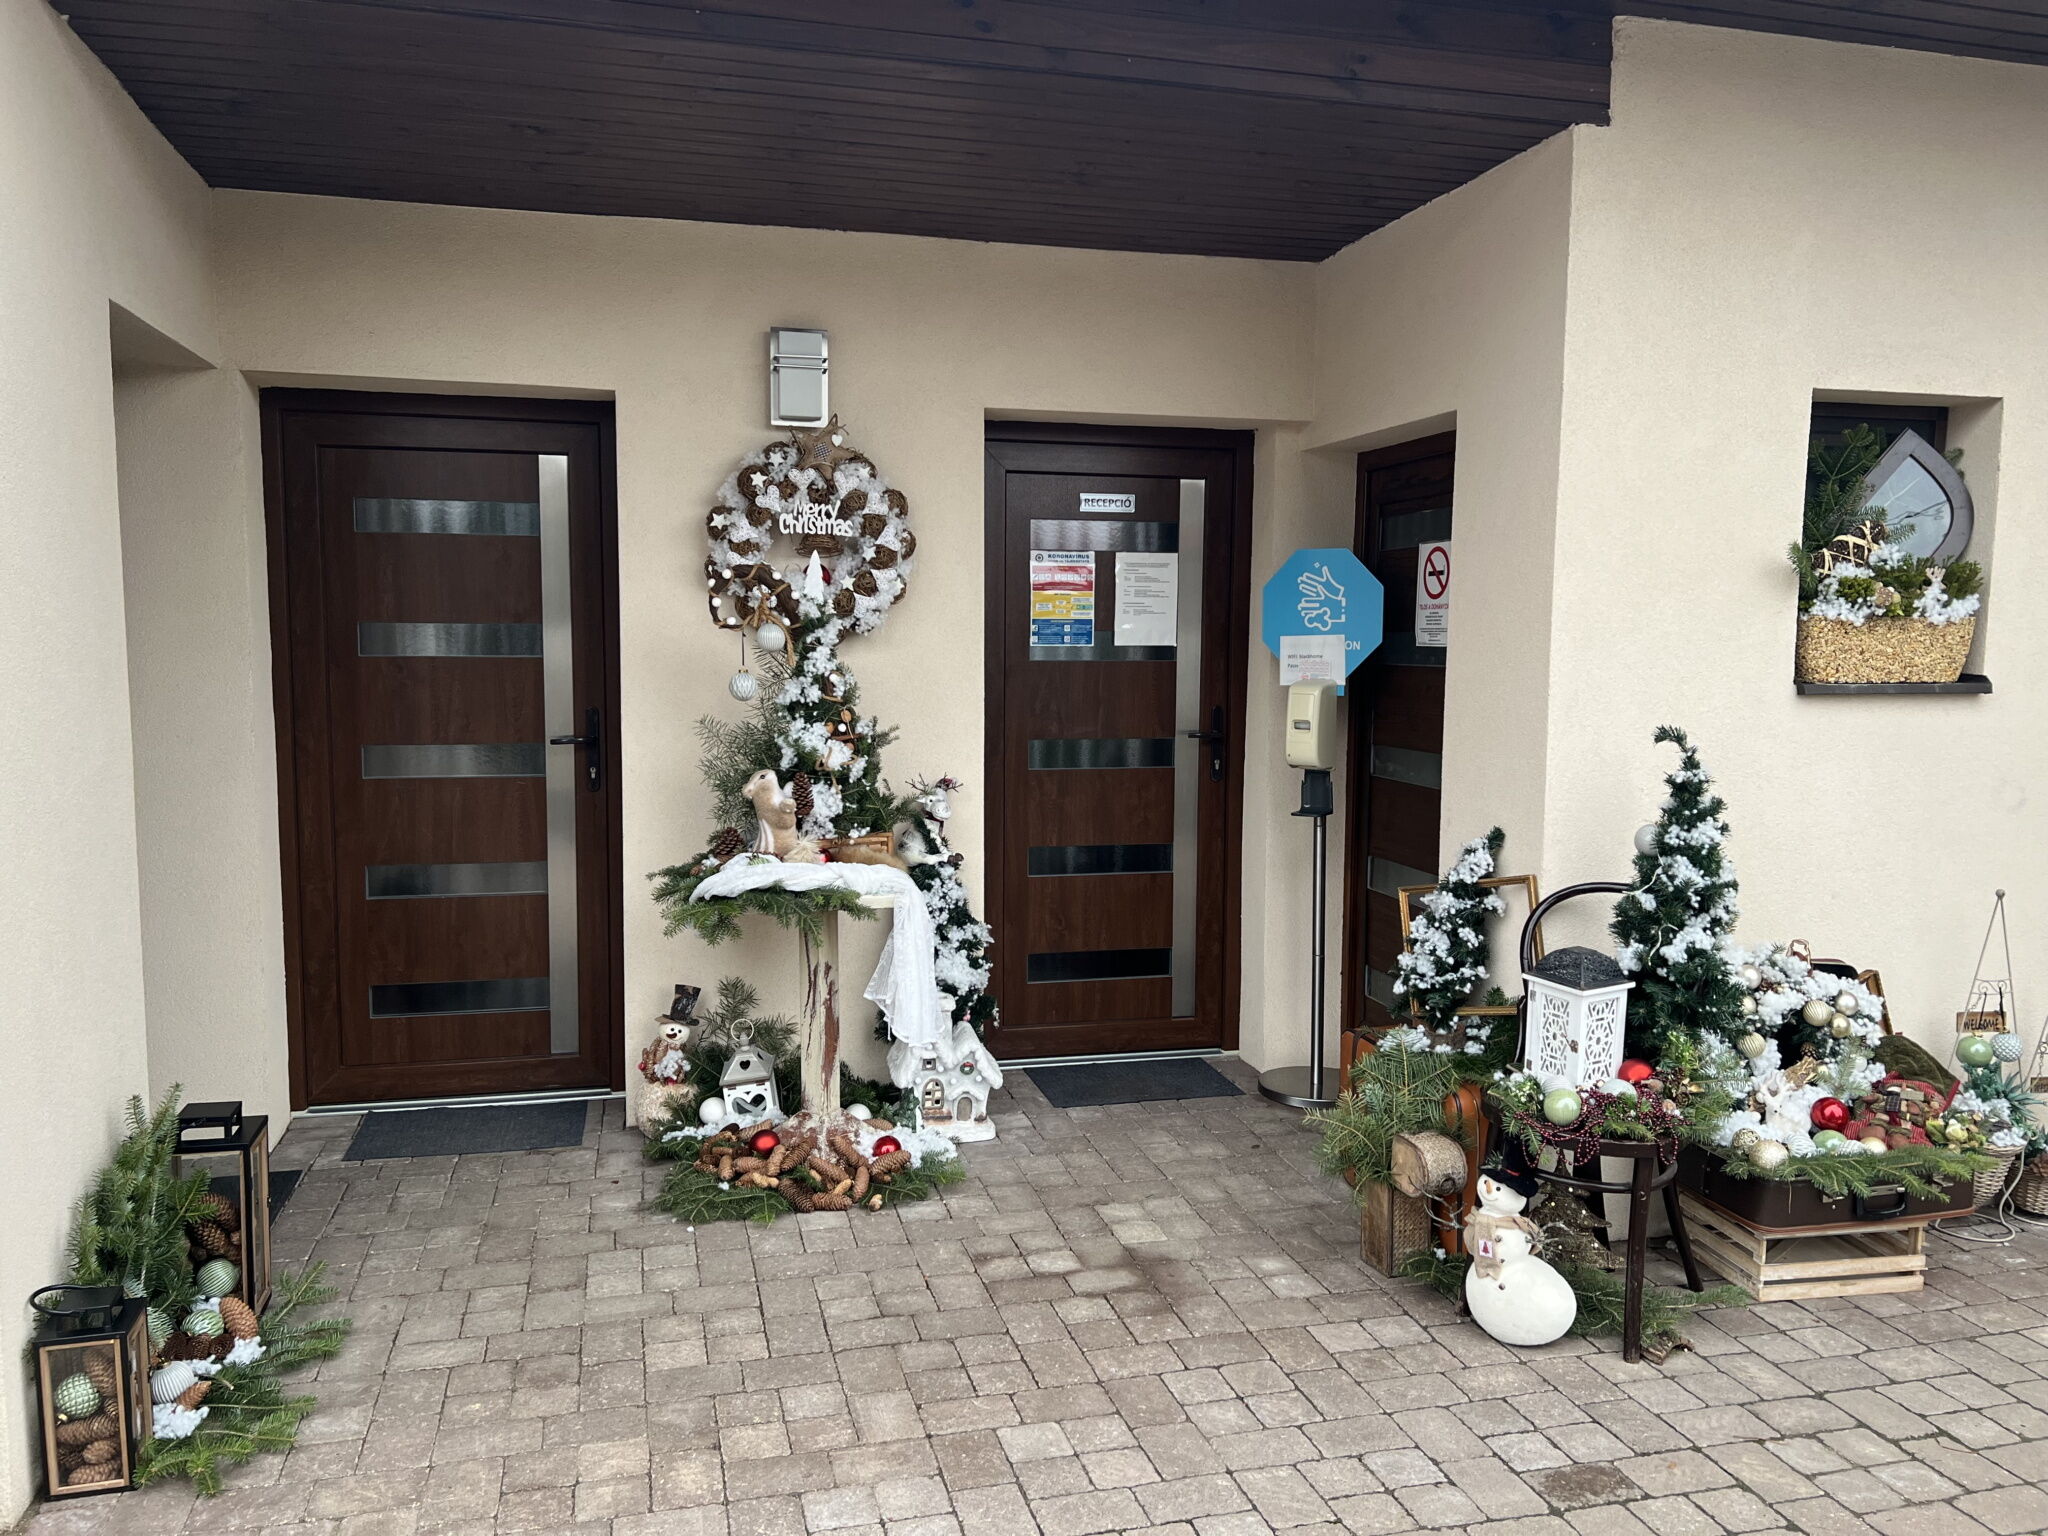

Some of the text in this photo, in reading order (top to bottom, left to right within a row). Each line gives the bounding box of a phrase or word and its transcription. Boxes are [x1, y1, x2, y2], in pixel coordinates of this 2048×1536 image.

[1084, 496, 1132, 508] RECEPCIÓ
[794, 500, 841, 519] Merry
[779, 513, 854, 536] Christmas
[1345, 640, 1361, 650] ON
[1964, 1018, 1999, 1030] WELCOME
